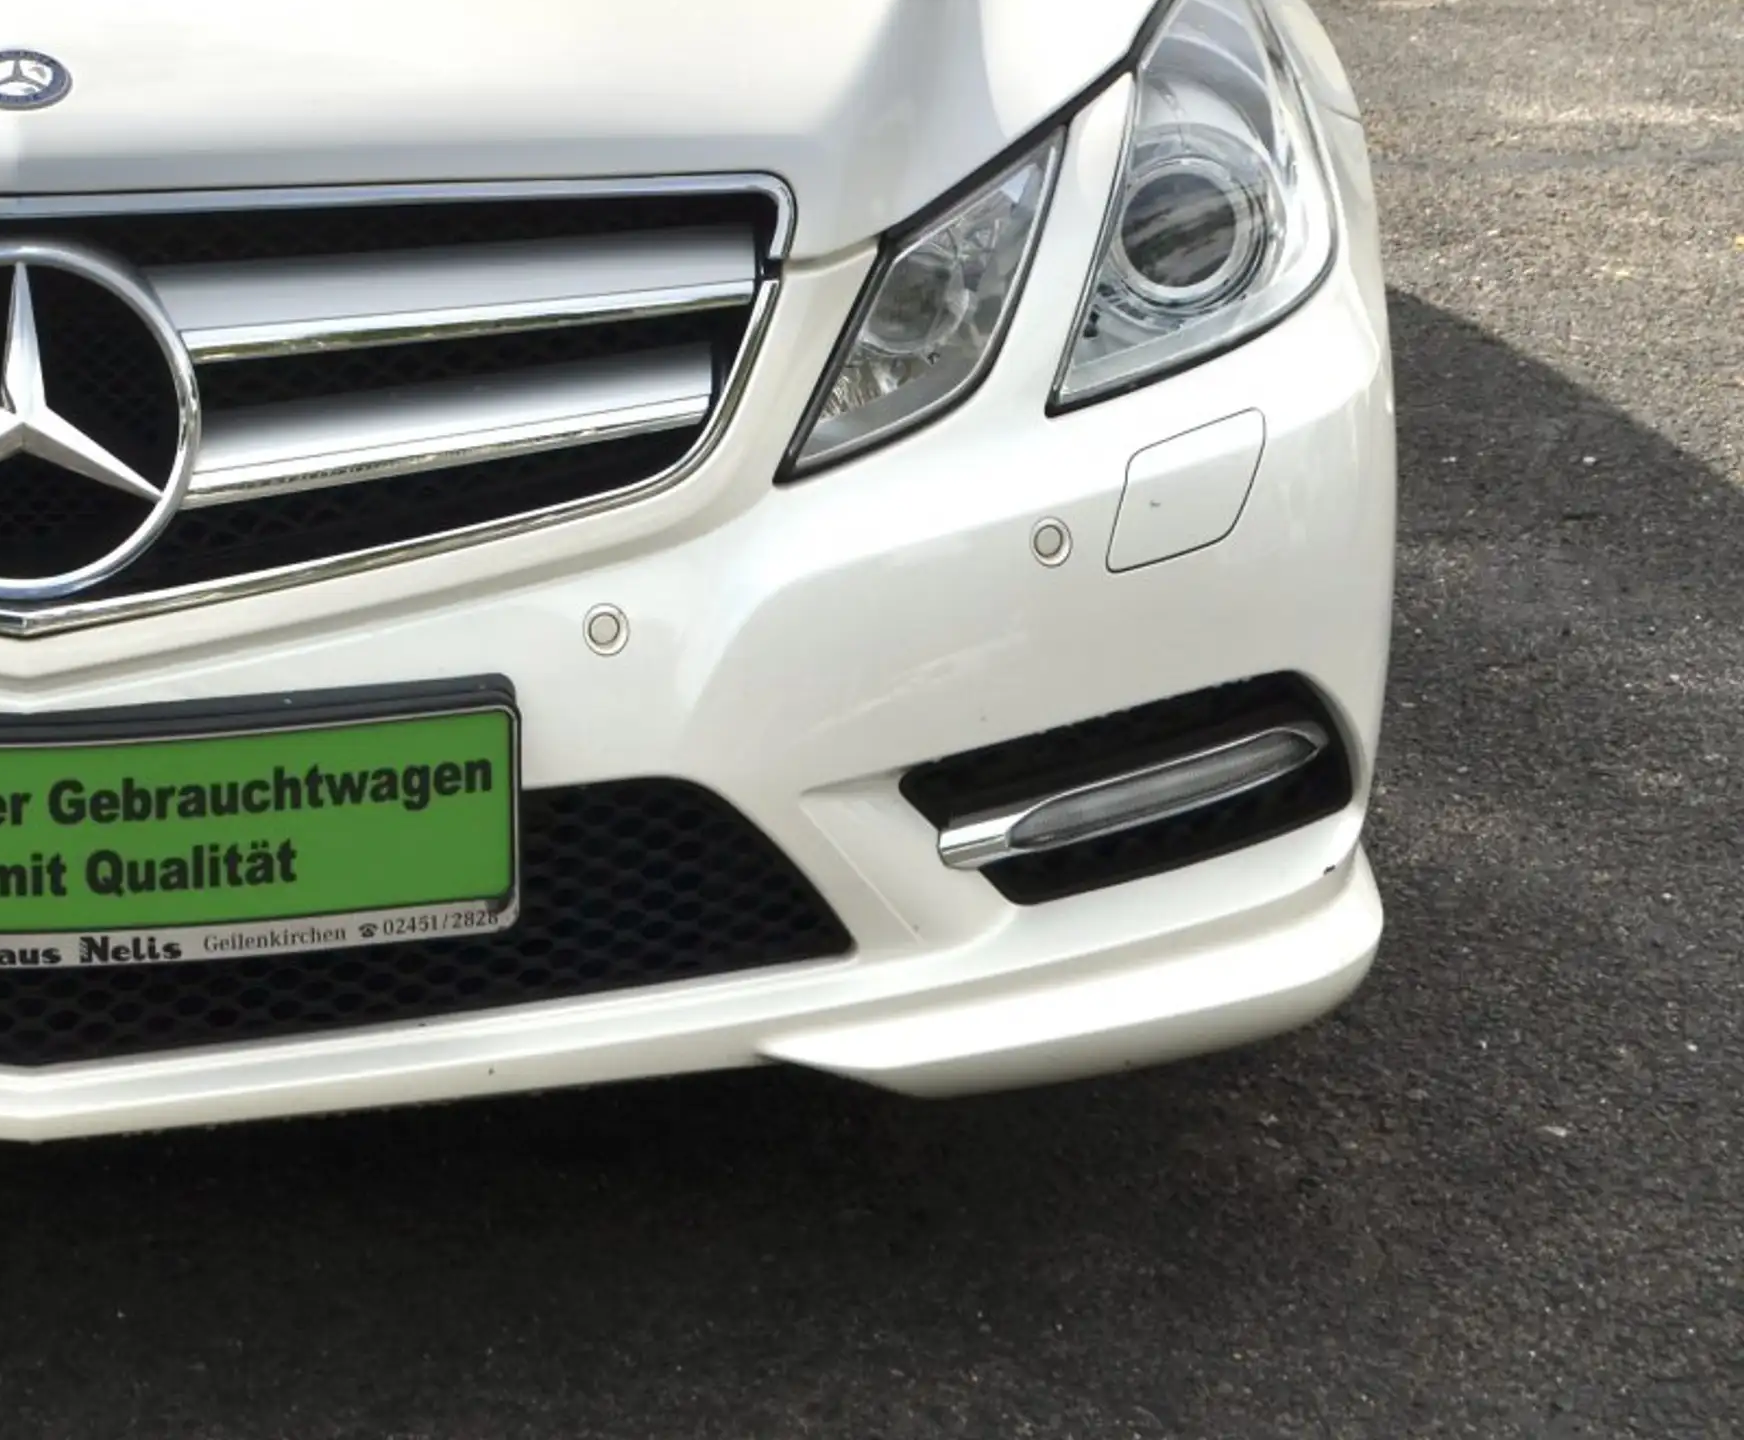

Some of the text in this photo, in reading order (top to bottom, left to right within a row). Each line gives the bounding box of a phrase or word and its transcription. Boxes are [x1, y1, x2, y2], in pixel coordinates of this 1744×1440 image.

[47, 758, 493, 825] Gebrauchtwagen
[85, 838, 298, 898] Qualität
[78, 935, 182, 964] Nelis
[203, 926, 347, 952] Geilenkirchen
